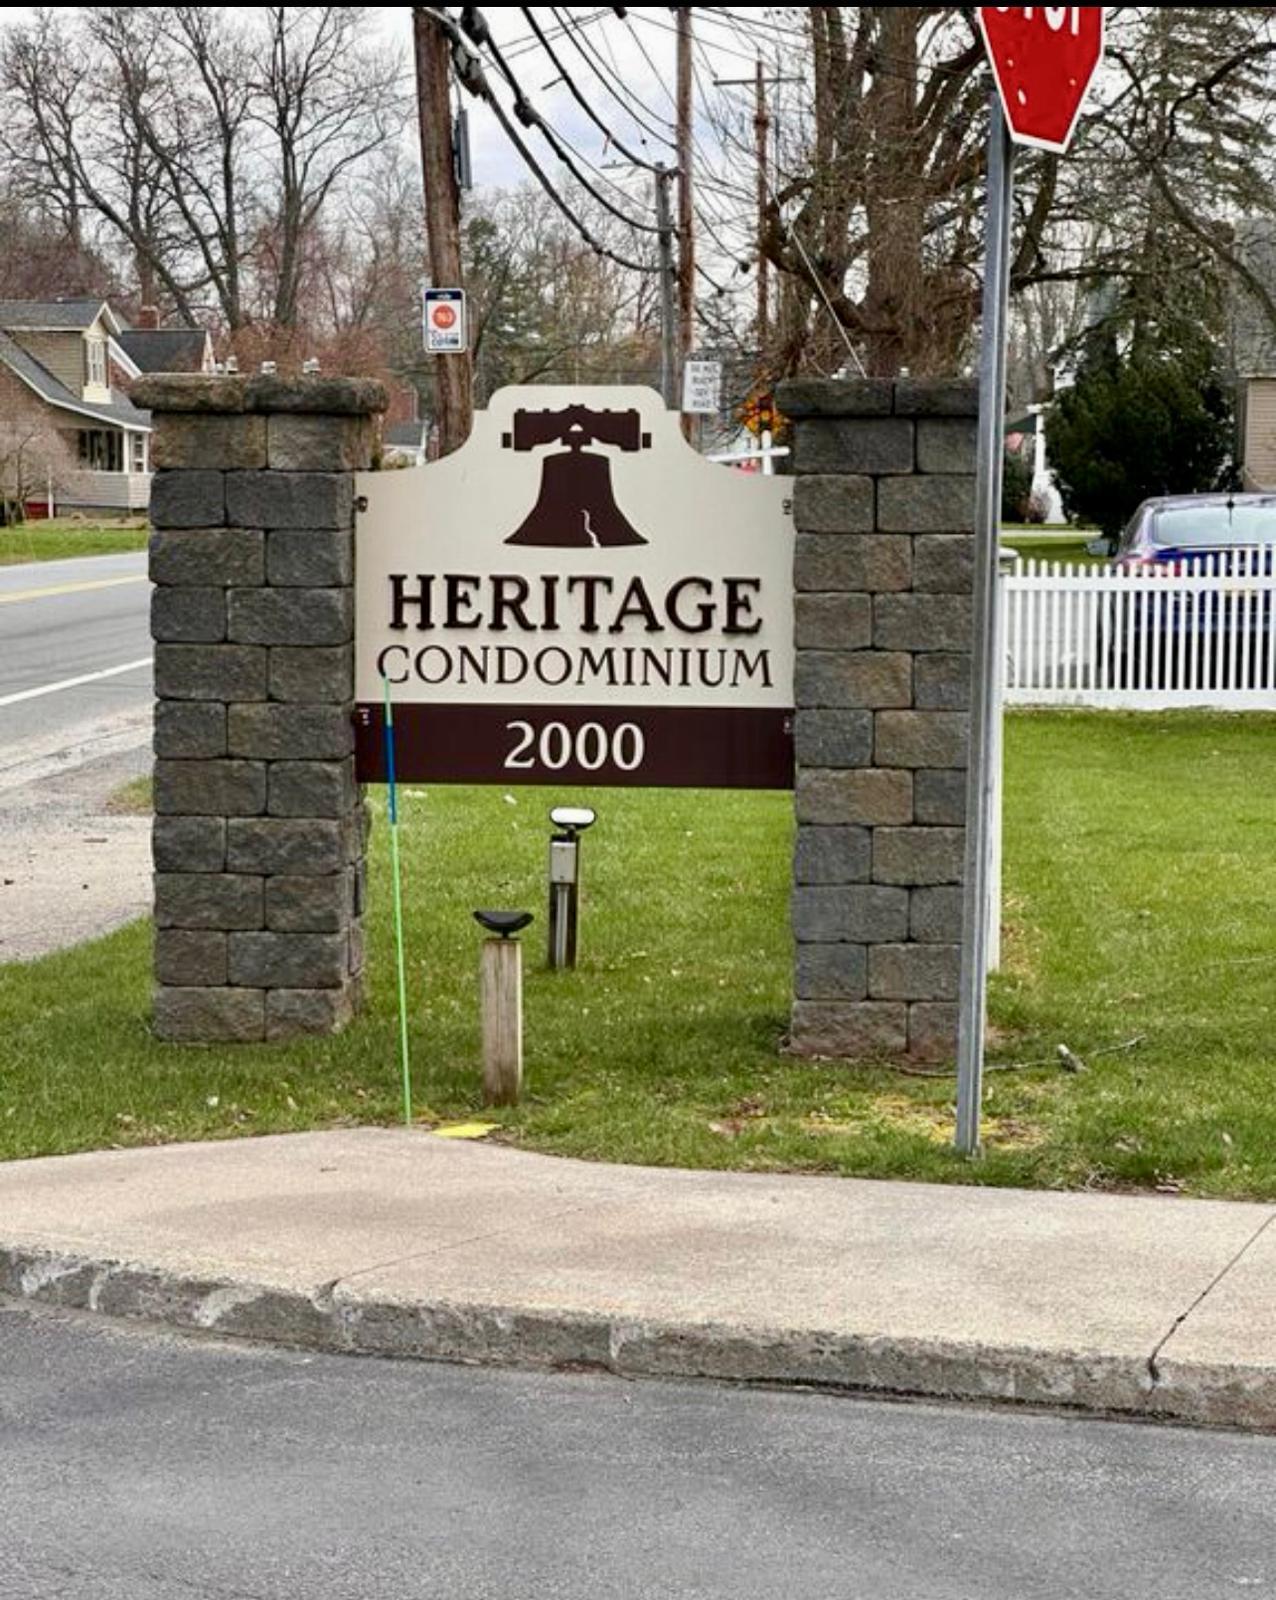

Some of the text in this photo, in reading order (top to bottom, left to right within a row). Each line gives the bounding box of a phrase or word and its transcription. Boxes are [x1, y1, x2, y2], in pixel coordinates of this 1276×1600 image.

[388, 574, 764, 635] HERITAGE
[377, 644, 774, 687] CONDOMINIUM
[504, 720, 644, 771] 2000
